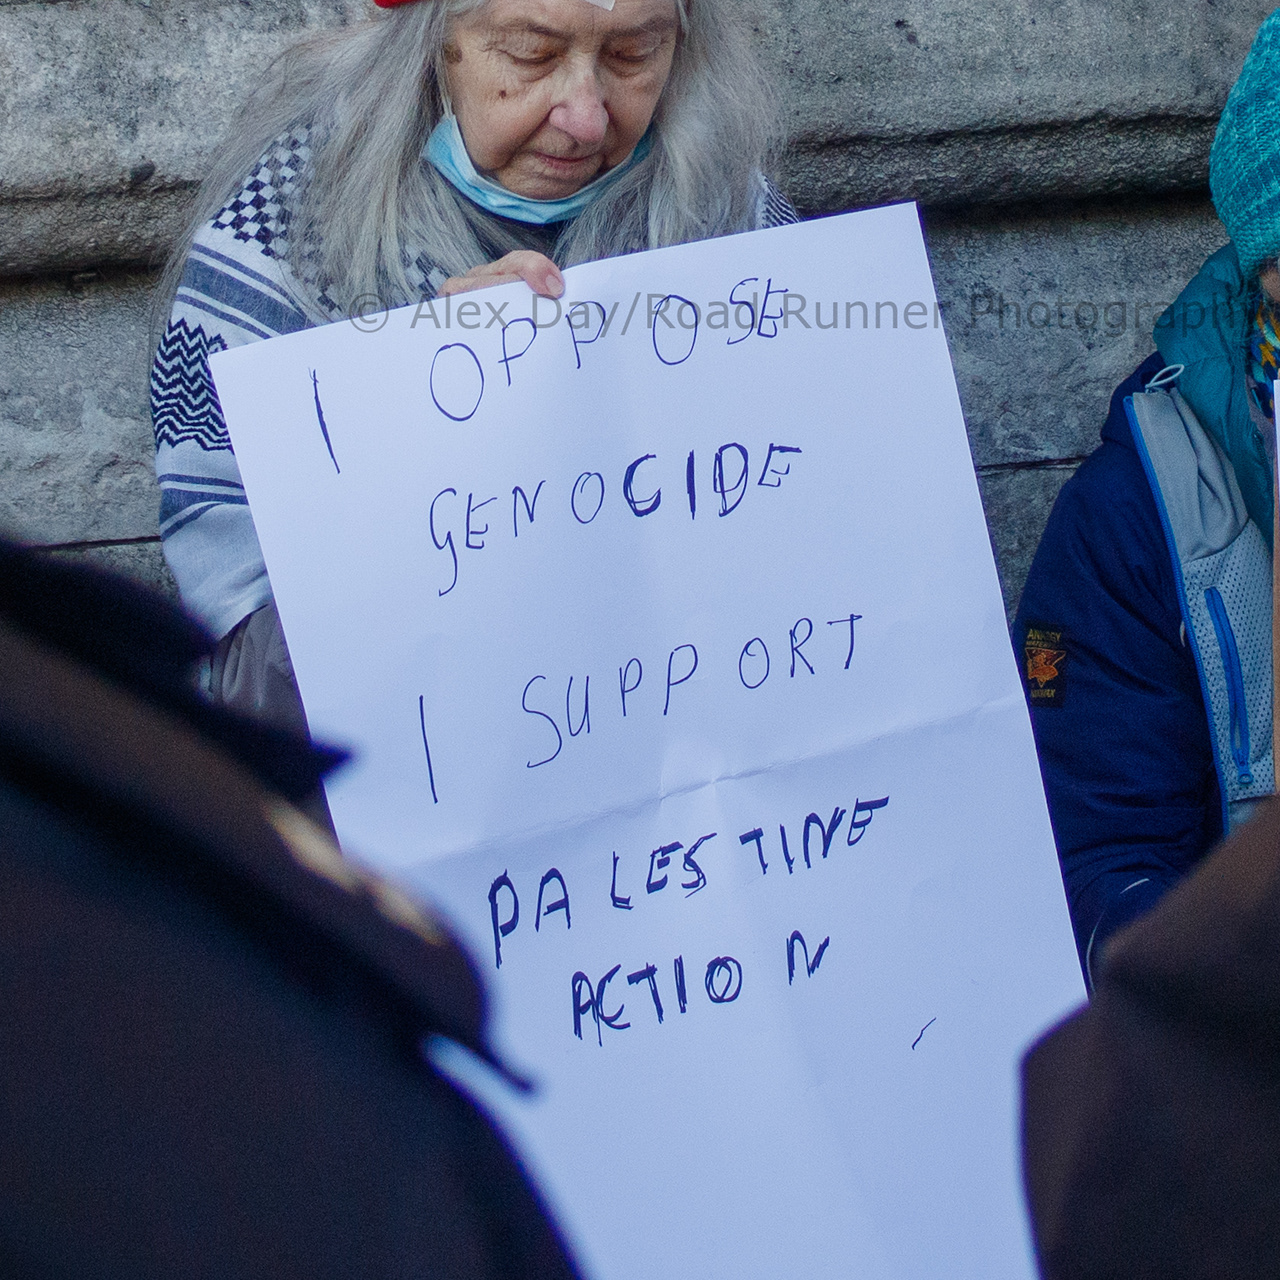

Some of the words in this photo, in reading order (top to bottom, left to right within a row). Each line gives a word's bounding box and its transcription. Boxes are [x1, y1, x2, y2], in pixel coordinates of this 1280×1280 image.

[311, 367, 341, 475] I
[429, 276, 790, 422] OPPOSE
[429, 443, 803, 597] GENOCIDE
[419, 695, 439, 804] I
[521, 614, 863, 769] SUPPORT
[487, 796, 890, 969] PALESTINE
[571, 930, 830, 1048] ACTION
